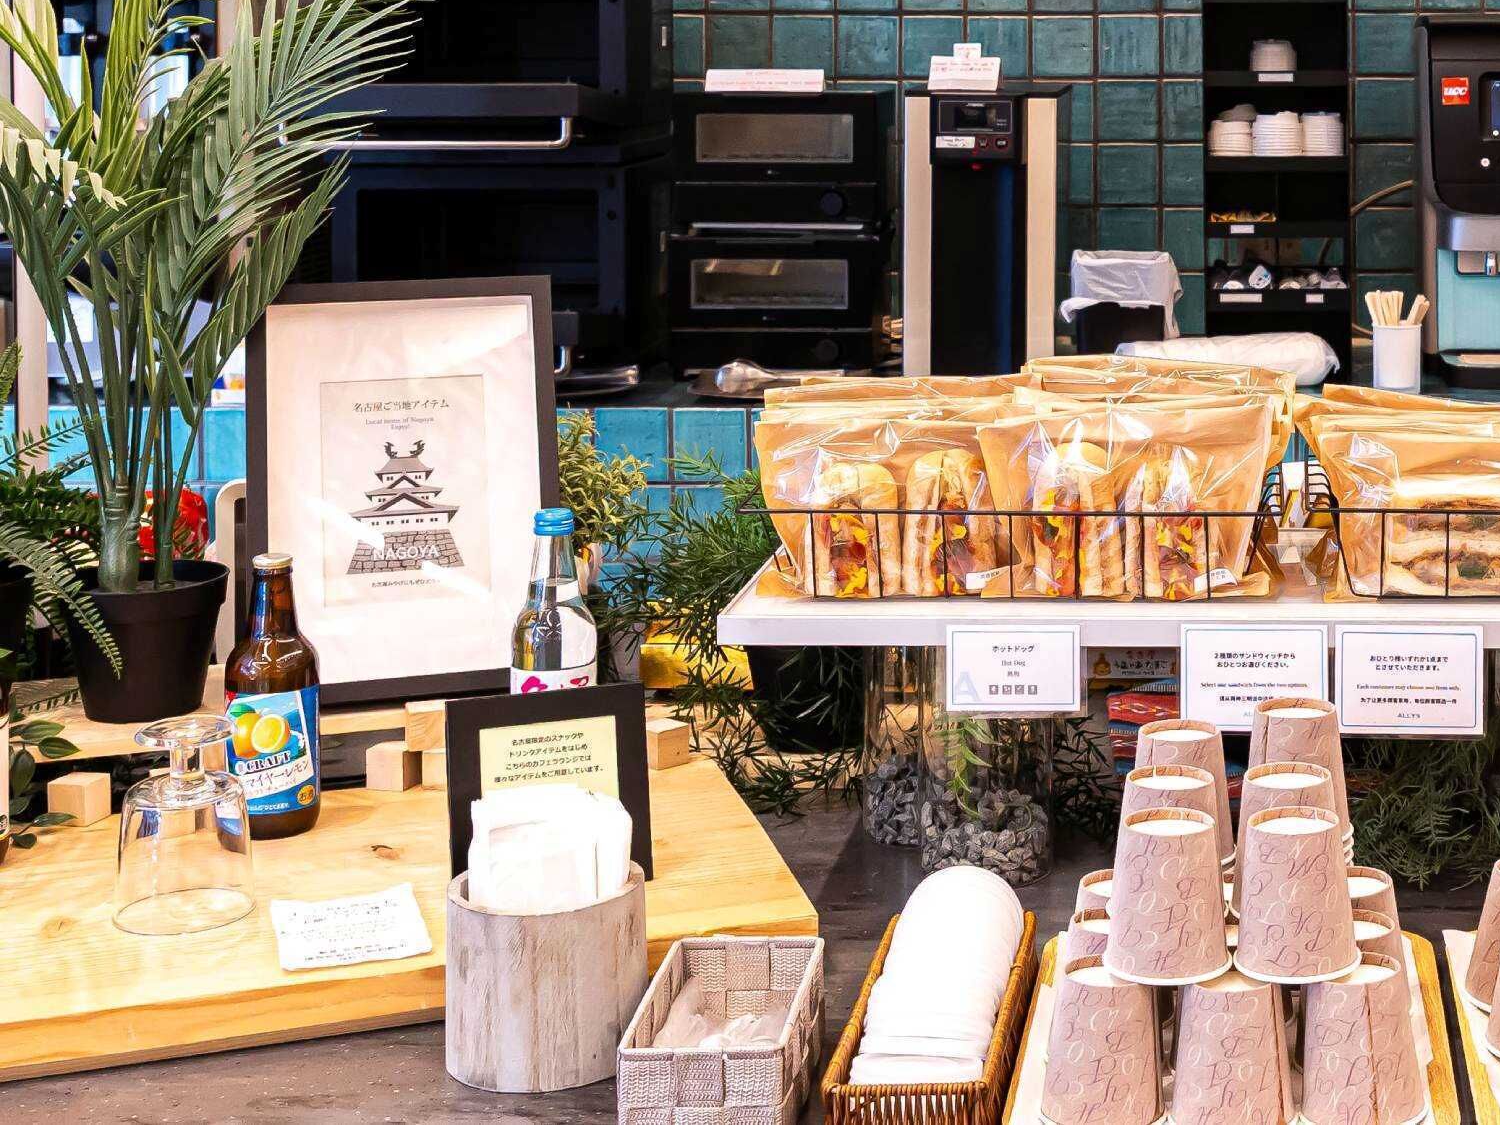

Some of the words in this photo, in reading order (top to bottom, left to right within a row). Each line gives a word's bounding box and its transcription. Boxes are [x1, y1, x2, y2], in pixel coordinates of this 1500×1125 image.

[353, 399, 449, 412] 名古屋ご当地アイテム
[373, 545, 440, 561] NAGOYA
[993, 645, 1034, 653] ホットドッグ
[512, 732, 584, 746] 名古屋限定のスナックや
[509, 743, 588, 758] ドリンクアイテムをはじめ
[247, 751, 291, 773] CRAFT
[506, 755, 591, 770] こちらのカフェラウンジでは
[494, 765, 604, 783] 様々なアイテムをご用意しています。
